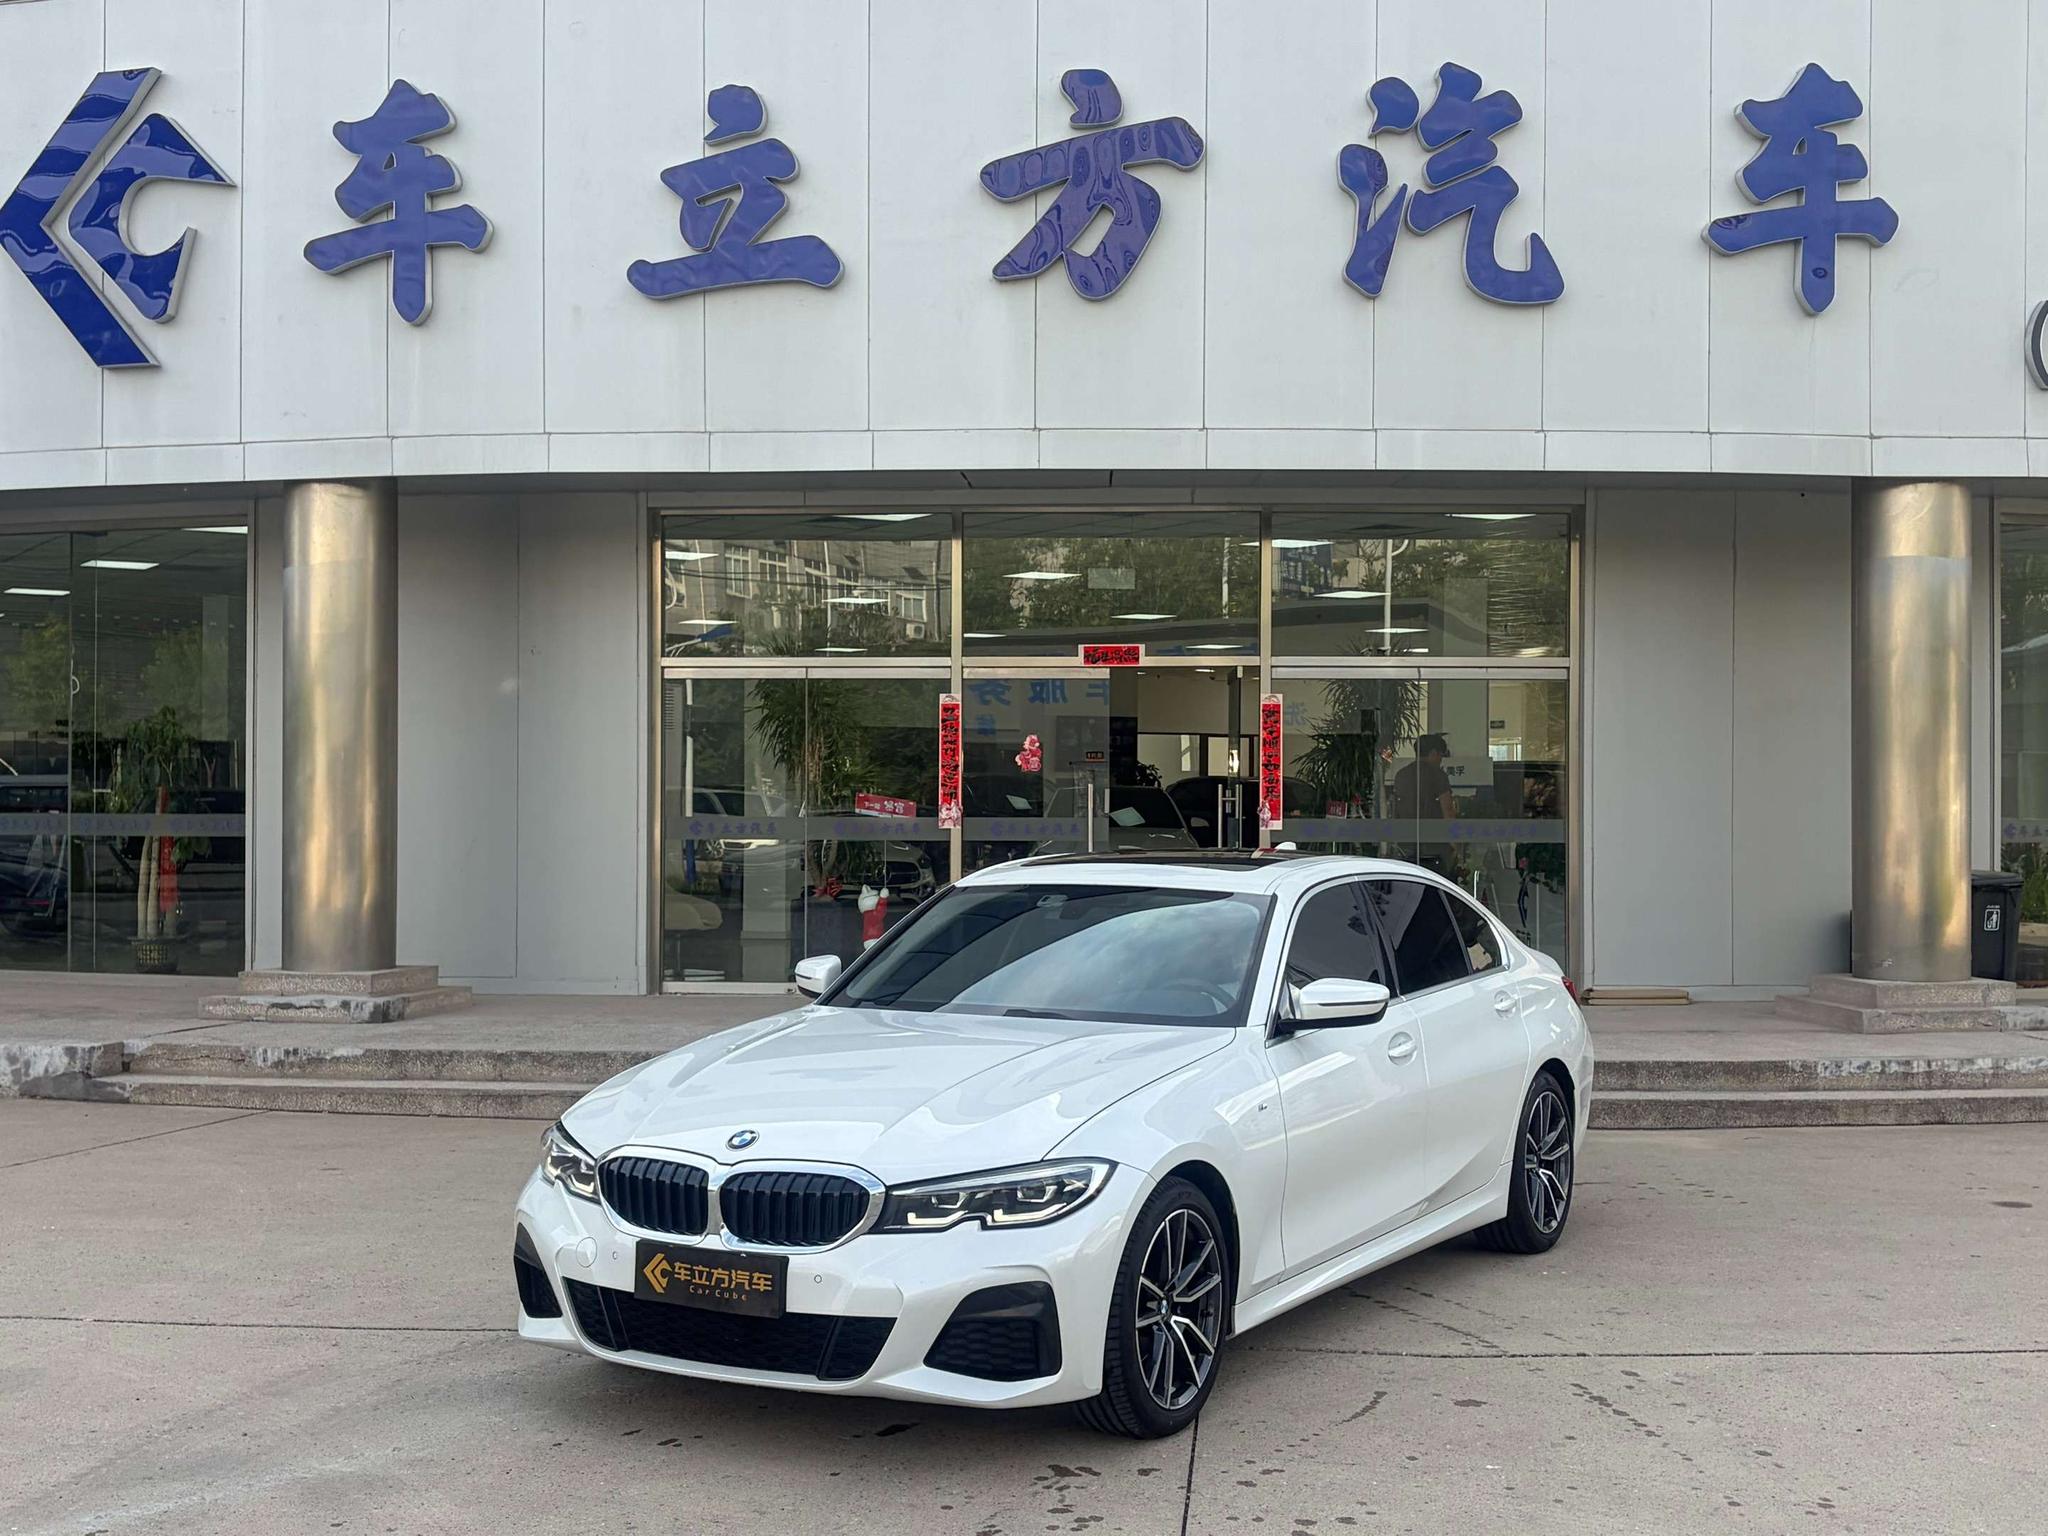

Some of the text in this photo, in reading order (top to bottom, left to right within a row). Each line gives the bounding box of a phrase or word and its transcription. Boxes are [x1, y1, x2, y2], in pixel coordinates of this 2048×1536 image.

[304, 62, 1899, 327] 车立方汽车
[673, 1261, 773, 1292] 车立方汽车
